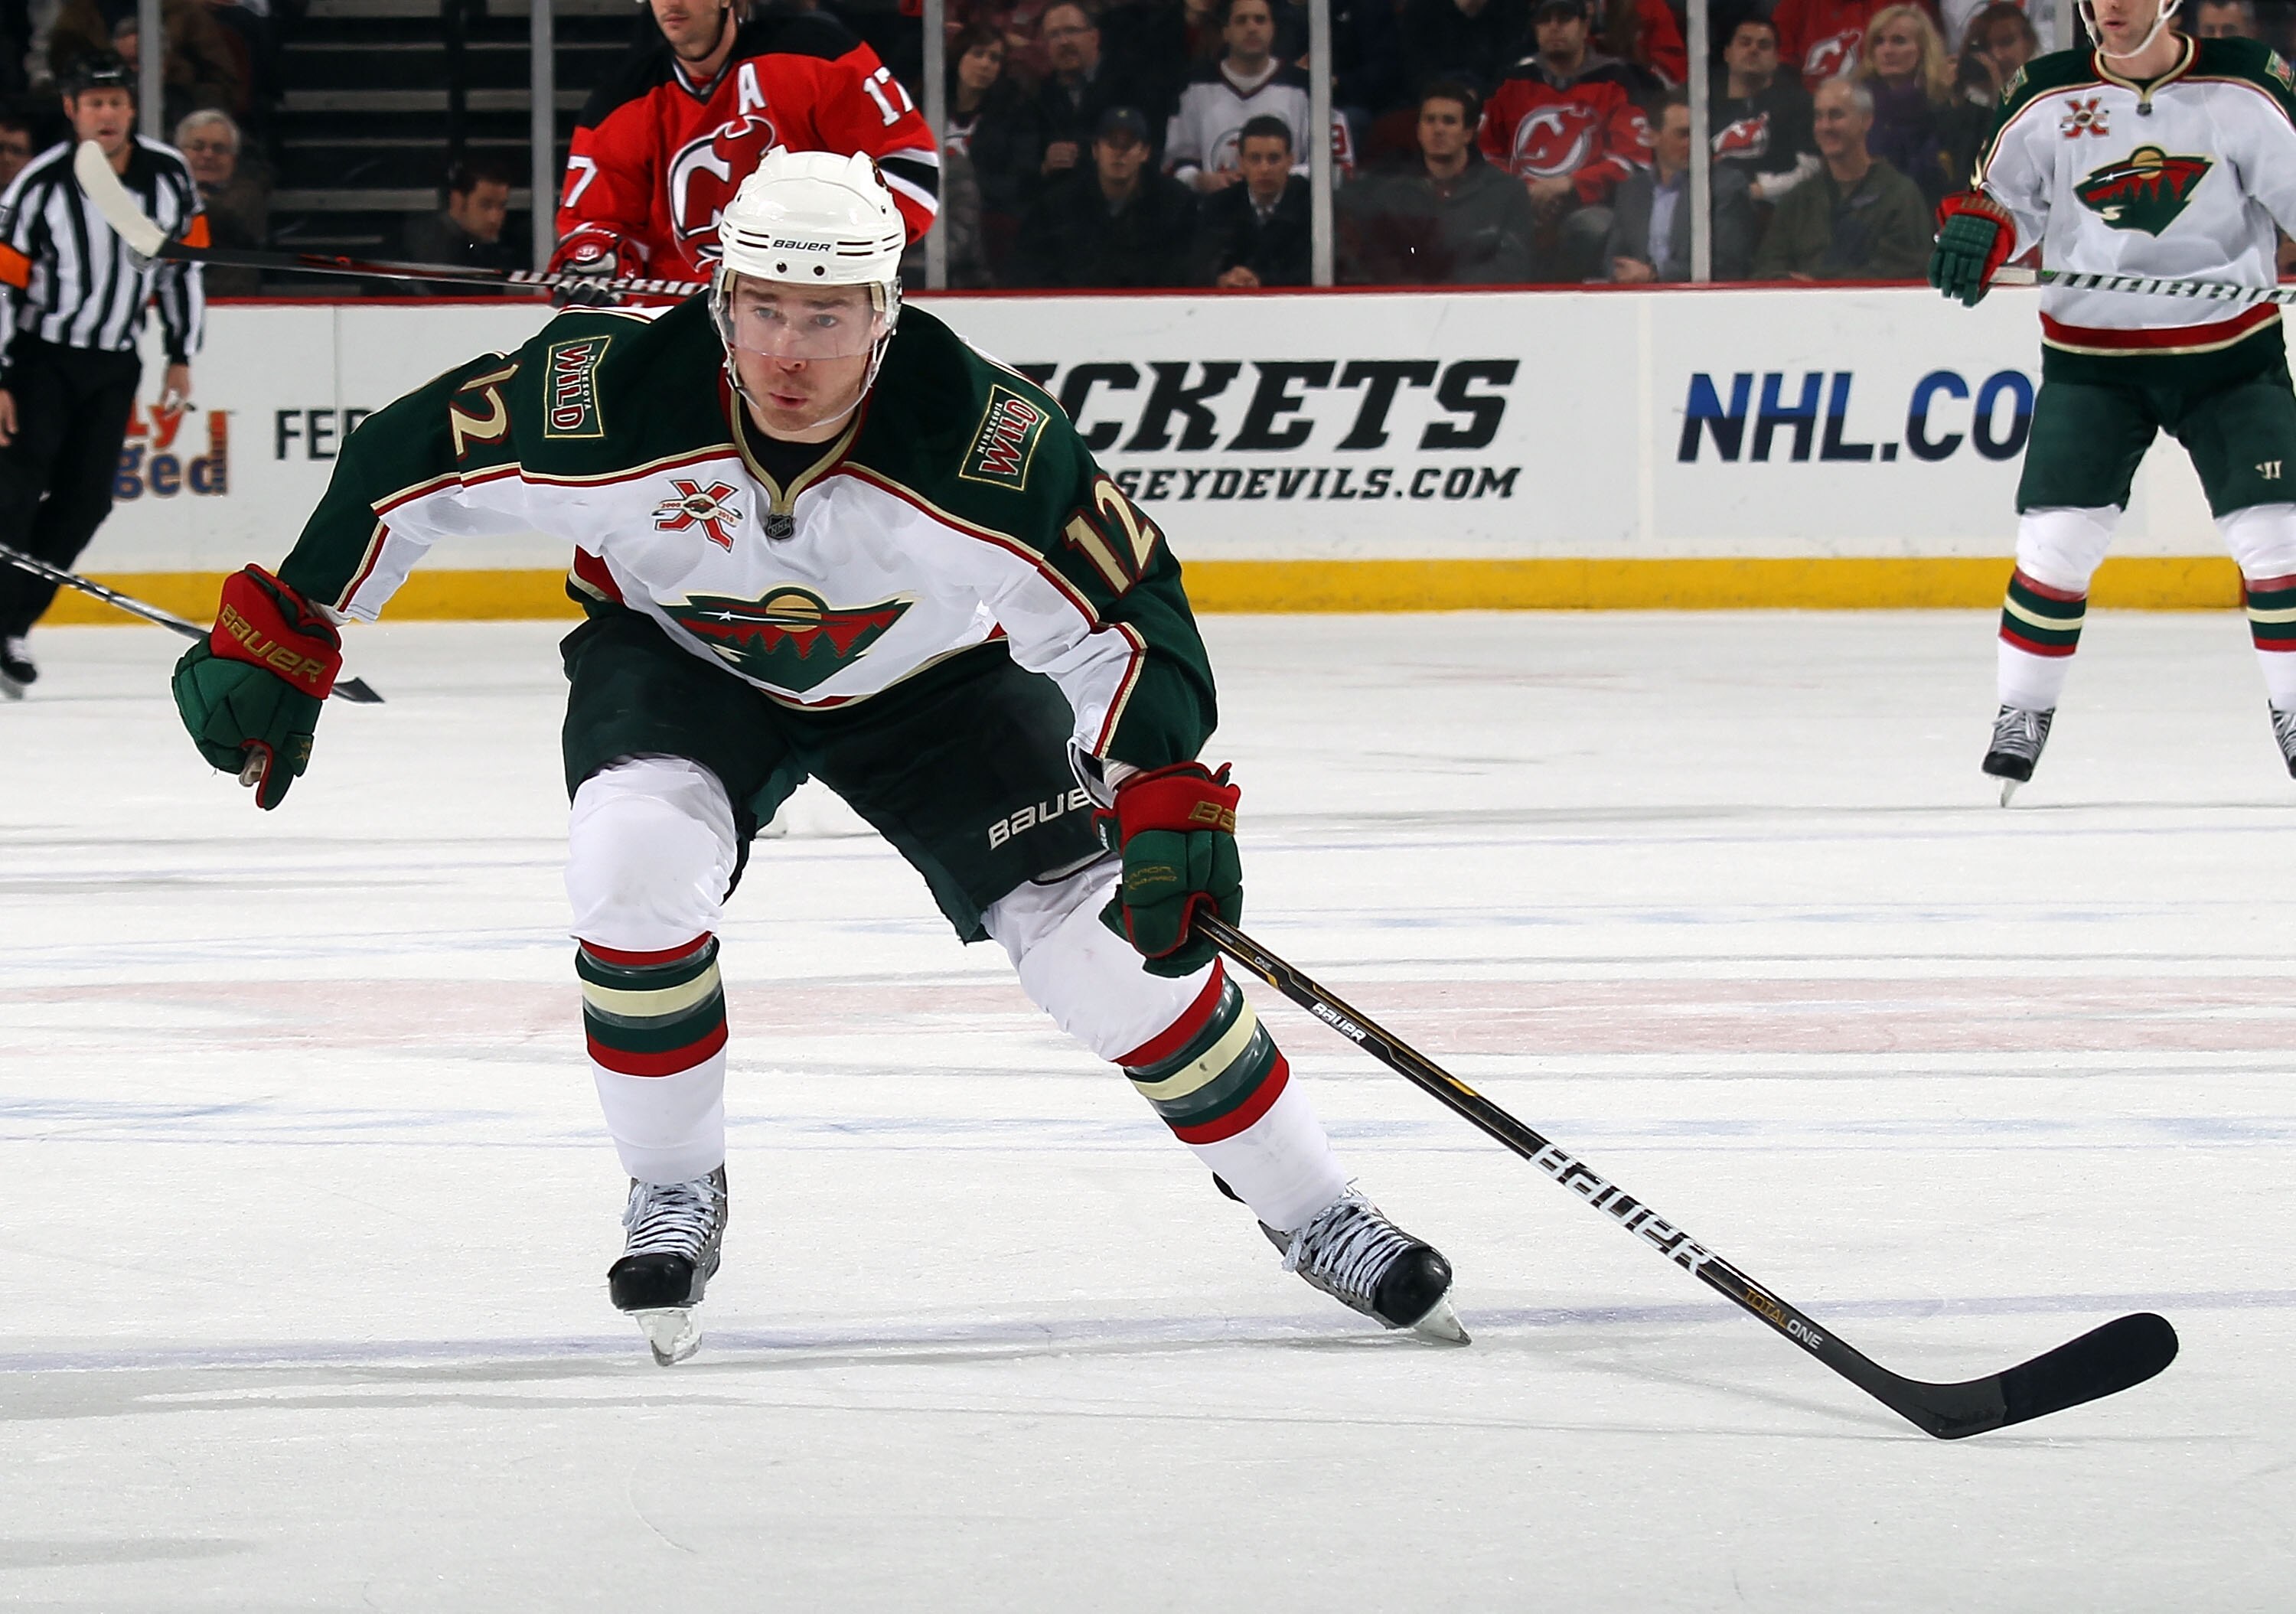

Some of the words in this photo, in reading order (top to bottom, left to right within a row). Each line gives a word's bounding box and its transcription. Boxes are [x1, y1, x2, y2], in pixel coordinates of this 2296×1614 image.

[737, 63, 766, 116] A
[772, 239, 832, 252] BAUER
[449, 360, 523, 463] 12
[551, 344, 593, 430] WILD
[580, 354, 597, 411] MINNESOTA
[977, 402, 1003, 455] MINNESOTA
[978, 399, 1039, 477] WILD
[1061, 473, 1159, 600] 12
[218, 603, 328, 684] BAUER
[1528, 1143, 1714, 1277] BAUER
